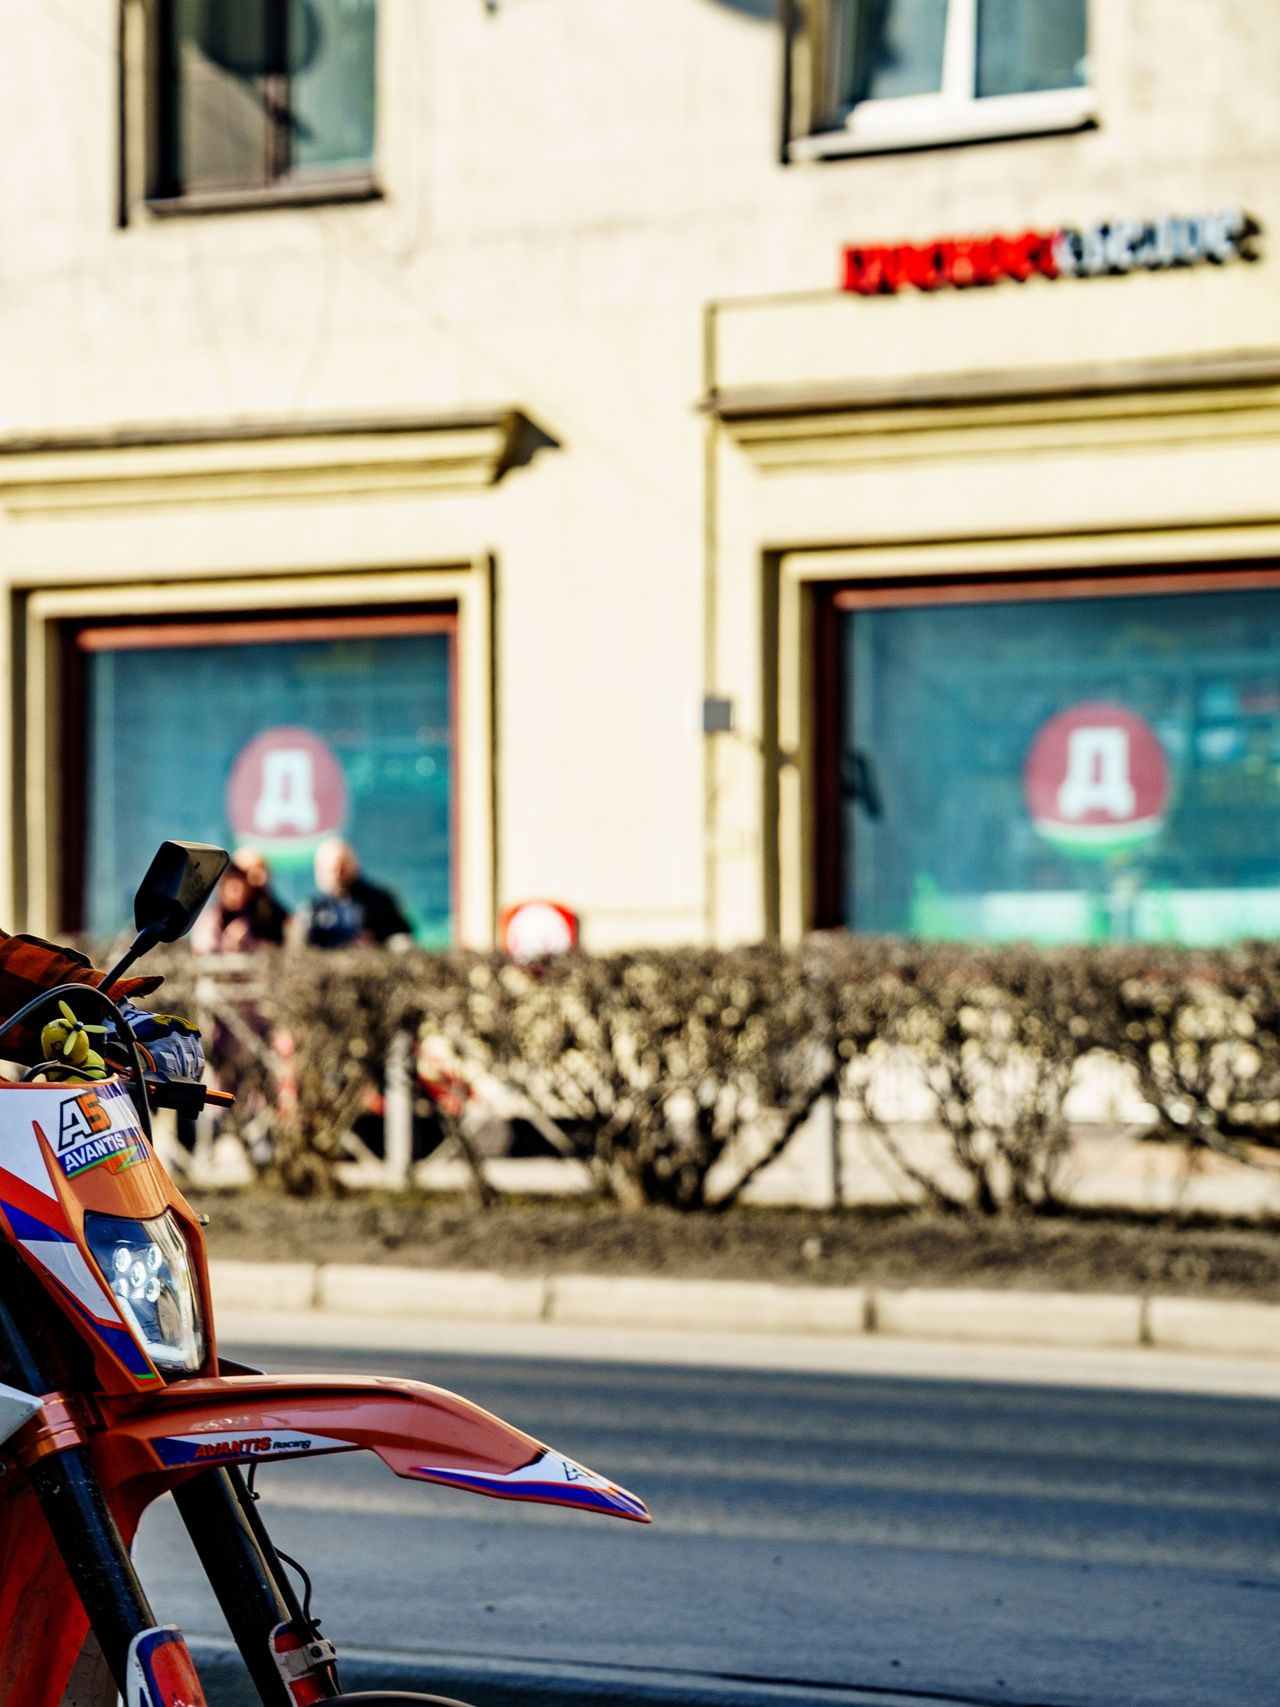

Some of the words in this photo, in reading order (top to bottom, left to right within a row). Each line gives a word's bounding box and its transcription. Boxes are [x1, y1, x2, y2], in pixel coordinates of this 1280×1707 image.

[254, 748, 318, 834] Д
[1057, 726, 1136, 820] Д
[58, 1090, 112, 1152] A5
[64, 1133, 126, 1172] AVANTIS
[194, 1436, 272, 1459] AVANTIS
[272, 1440, 312, 1450] Racing
